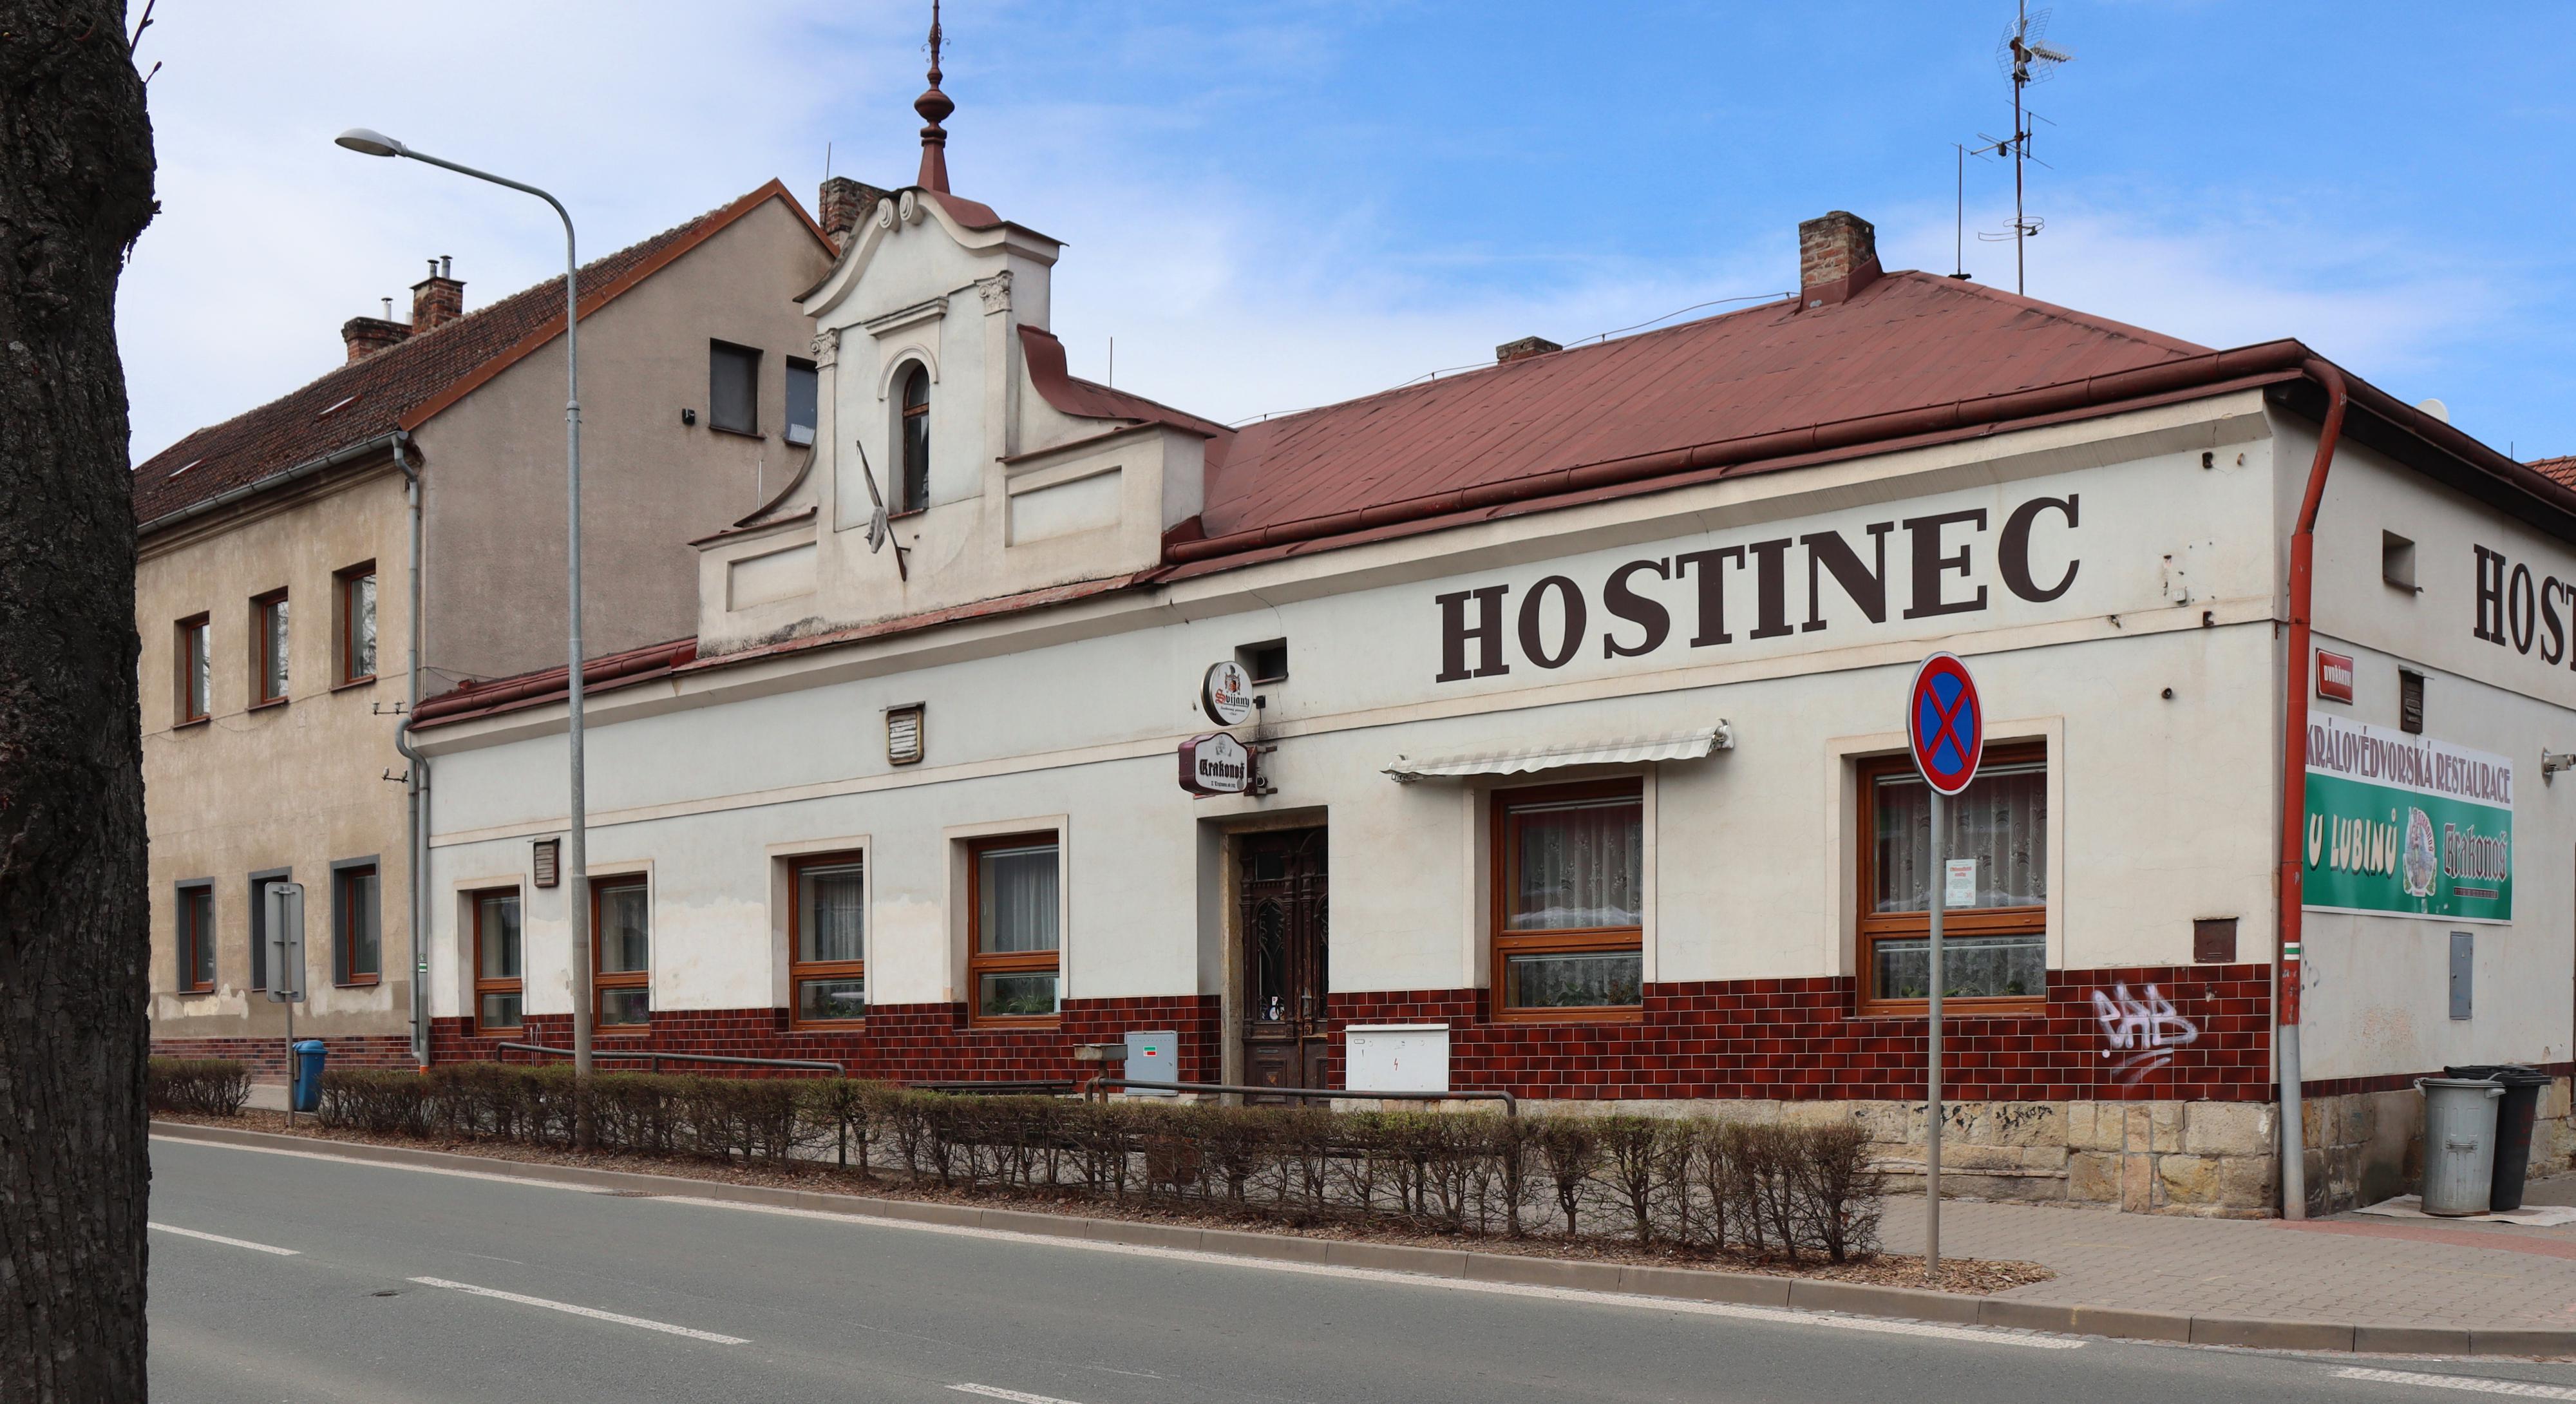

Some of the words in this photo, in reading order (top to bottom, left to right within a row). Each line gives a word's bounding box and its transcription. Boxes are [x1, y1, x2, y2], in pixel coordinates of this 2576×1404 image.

[1435, 493, 2079, 683] HOSTINEC
[1215, 688, 1249, 708] Svijany
[2306, 717, 2434, 788] KRÁLOVÉDVORSKÁ
[2436, 752, 2510, 804] RESTAURACE
[2309, 813, 2323, 869] U
[2330, 808, 2397, 878] LUBINŮ
[2443, 823, 2508, 882] Krakonoš
